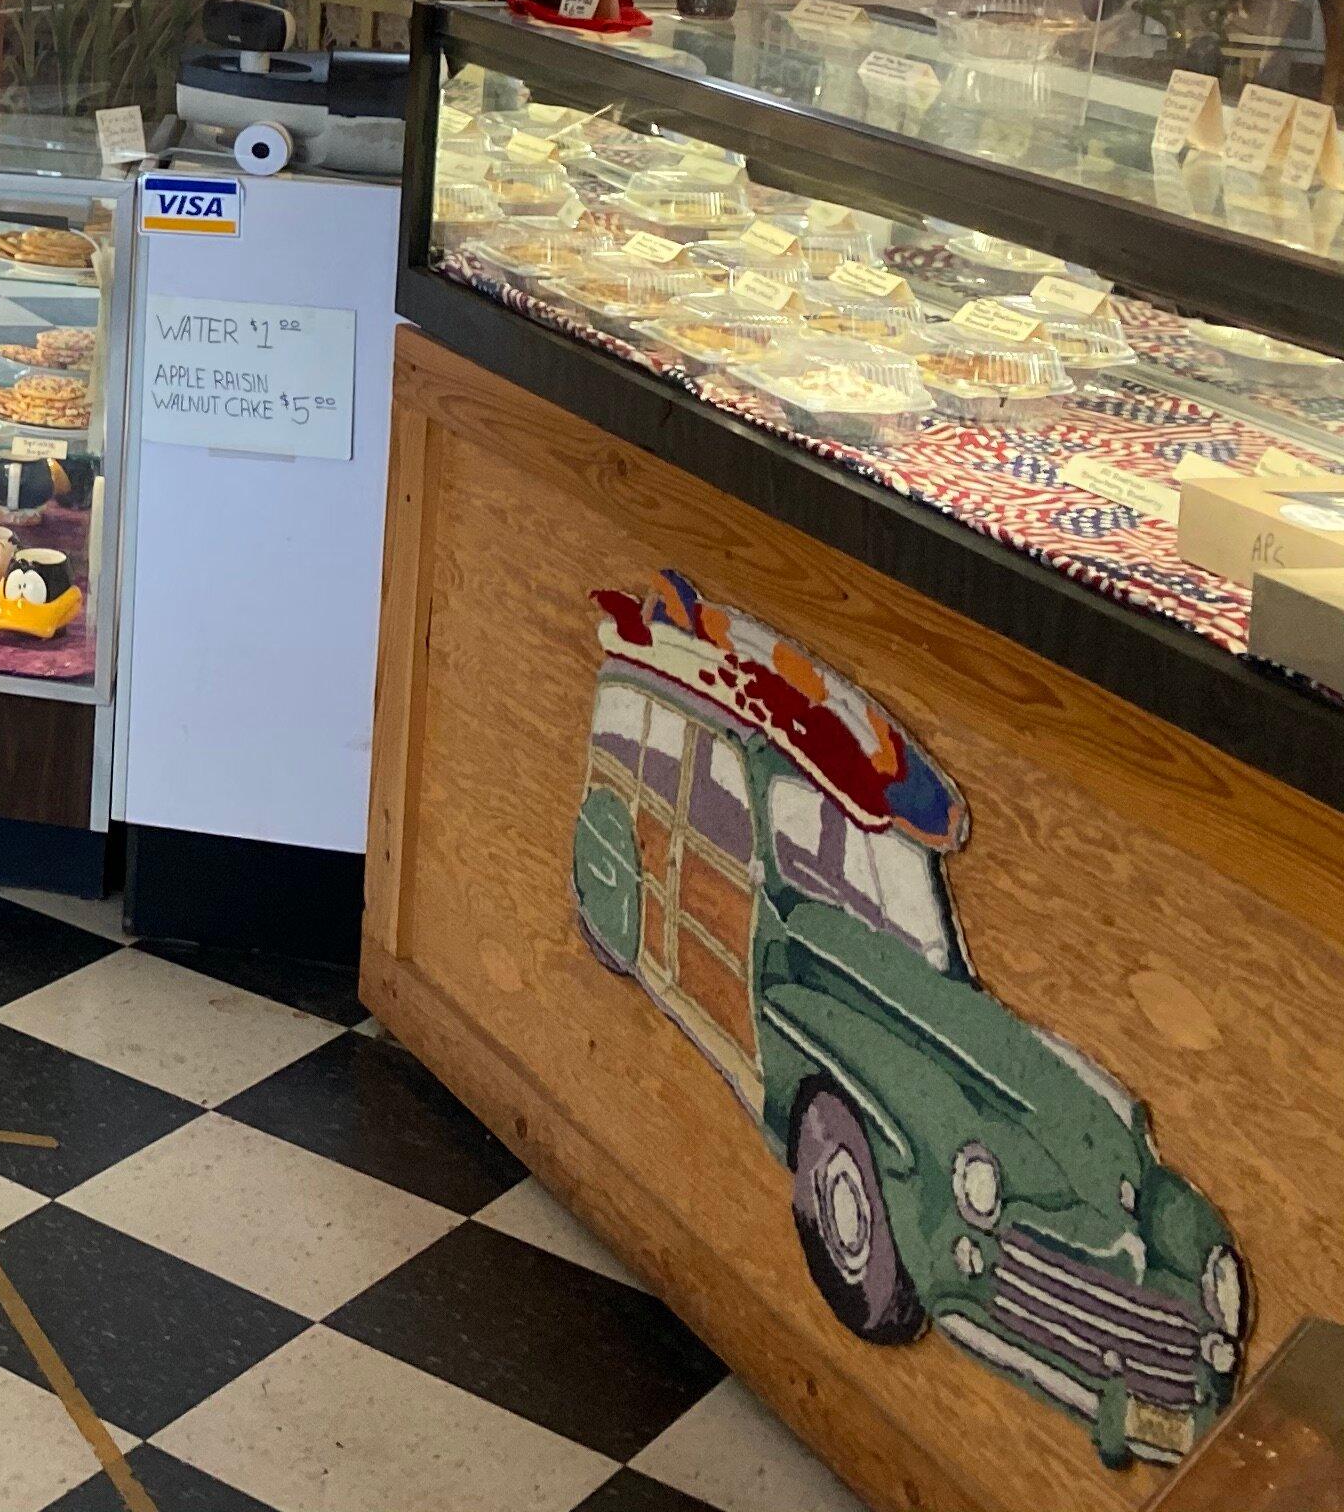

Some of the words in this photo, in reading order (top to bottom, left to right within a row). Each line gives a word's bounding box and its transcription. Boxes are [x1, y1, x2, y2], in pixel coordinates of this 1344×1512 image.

[157, 194, 224, 219] VISA
[155, 314, 240, 346] WATER
[154, 364, 207, 390] APPLE
[213, 368, 270, 393] RAISIN
[151, 391, 221, 416] WALNUT
[224, 397, 274, 421] CAKE
